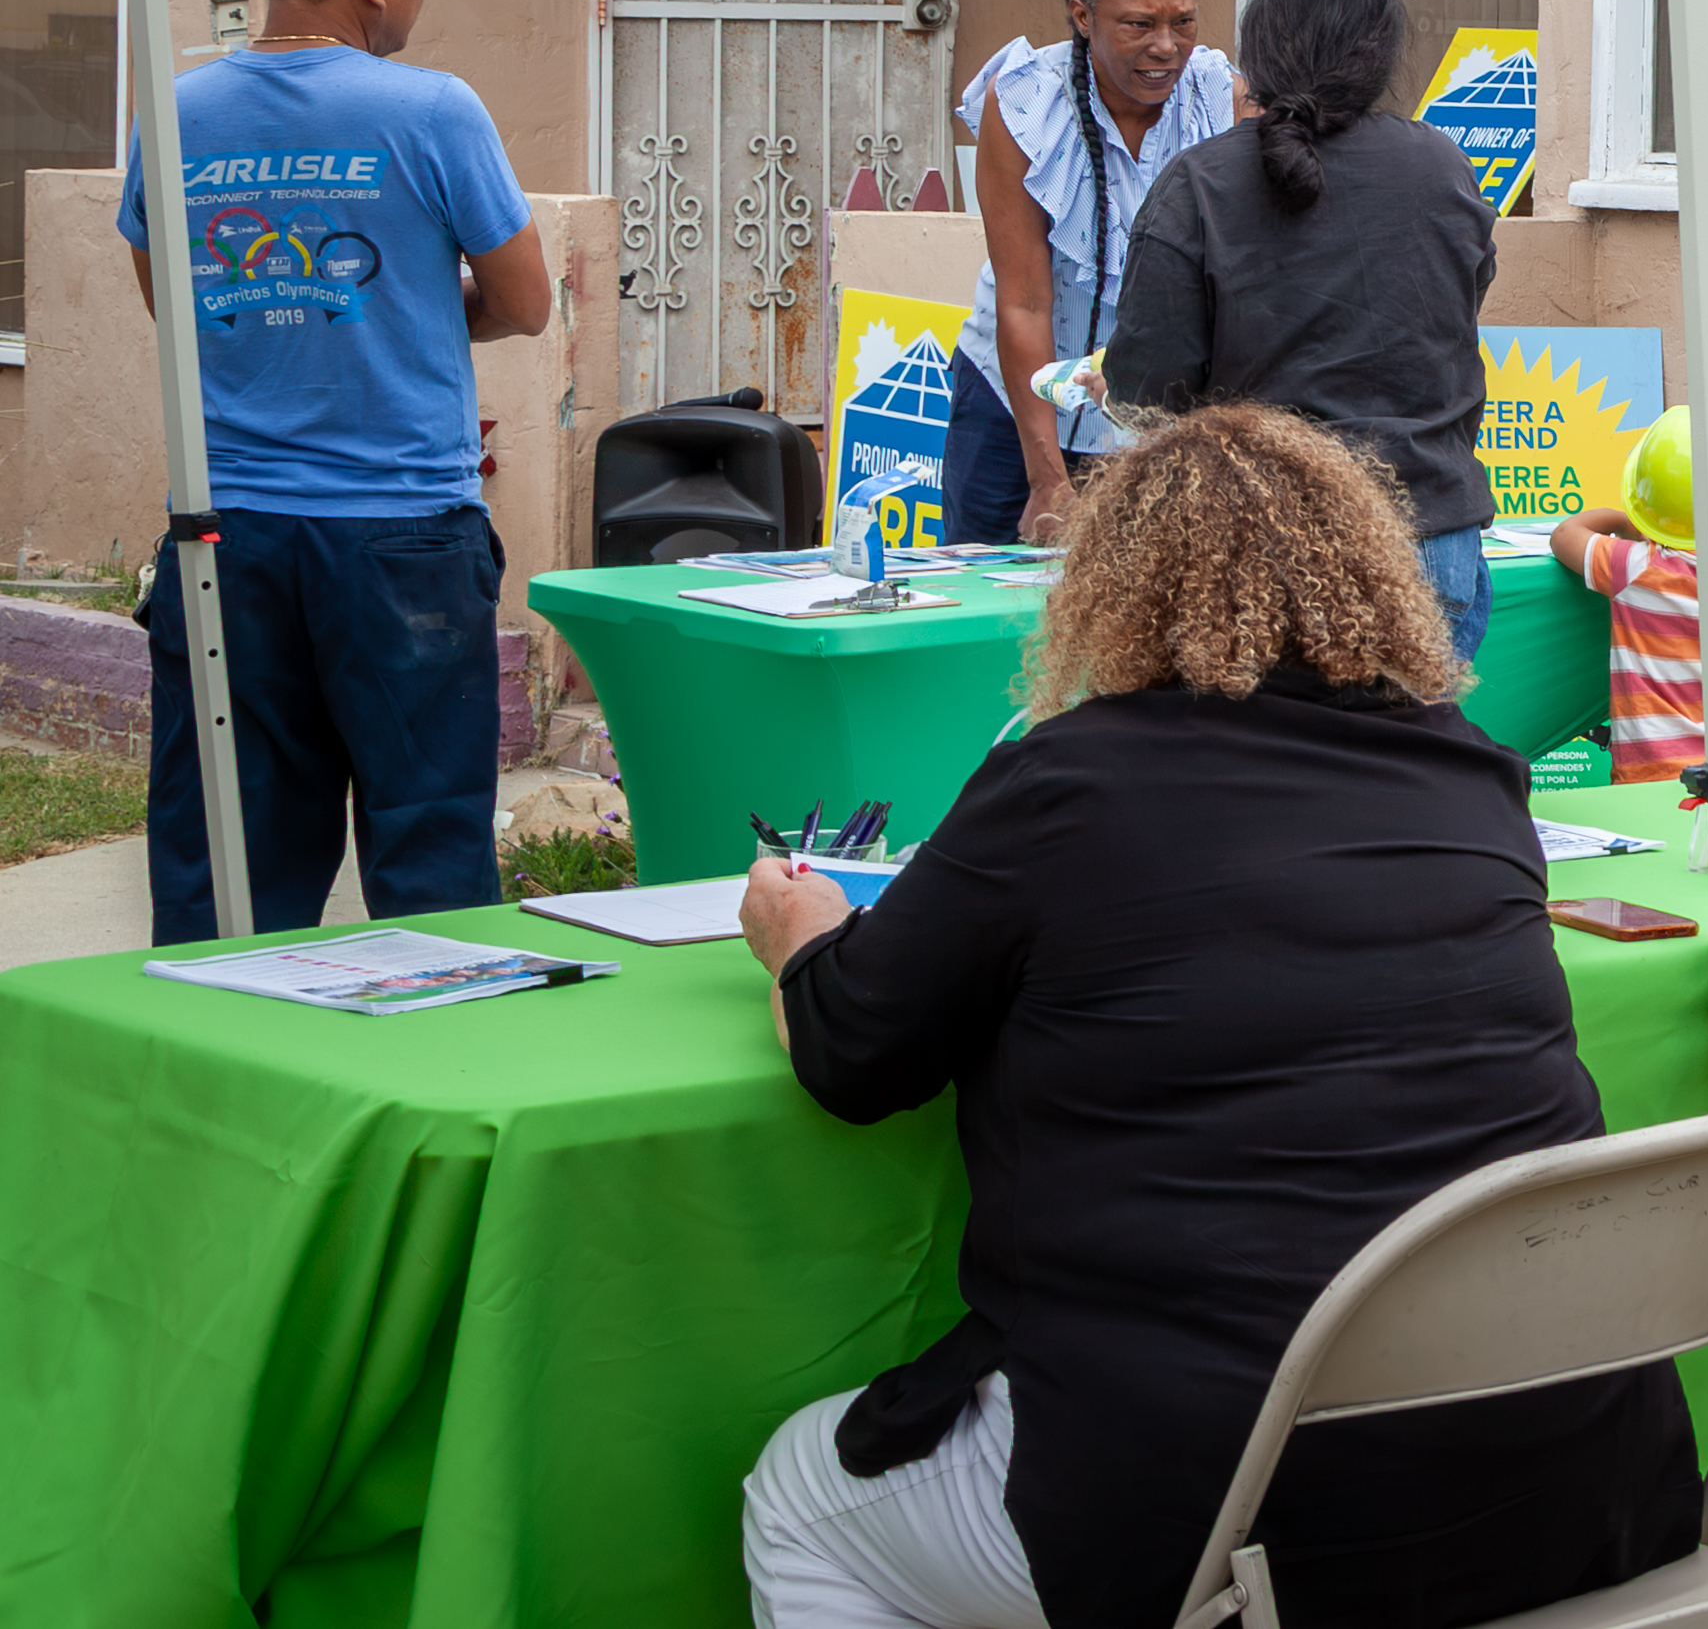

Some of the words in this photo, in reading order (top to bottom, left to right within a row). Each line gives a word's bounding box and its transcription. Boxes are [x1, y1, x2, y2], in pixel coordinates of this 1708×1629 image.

[1435, 125, 1467, 146] OUD
[1463, 126, 1514, 149] OWNER
[1511, 127, 1536, 149] OF
[270, 189, 381, 200] TECHNOLOGIES
[202, 285, 271, 311] Cerritos
[265, 308, 305, 326] 2019
[1543, 401, 1565, 424] A
[851, 441, 900, 477] PROUD
[1559, 465, 1581, 489] A
[1547, 751, 1589, 760] PERSONA
[1586, 763, 1592, 772] Y
[1547, 776, 1566, 784] POR
[1567, 775, 1579, 783] LA
